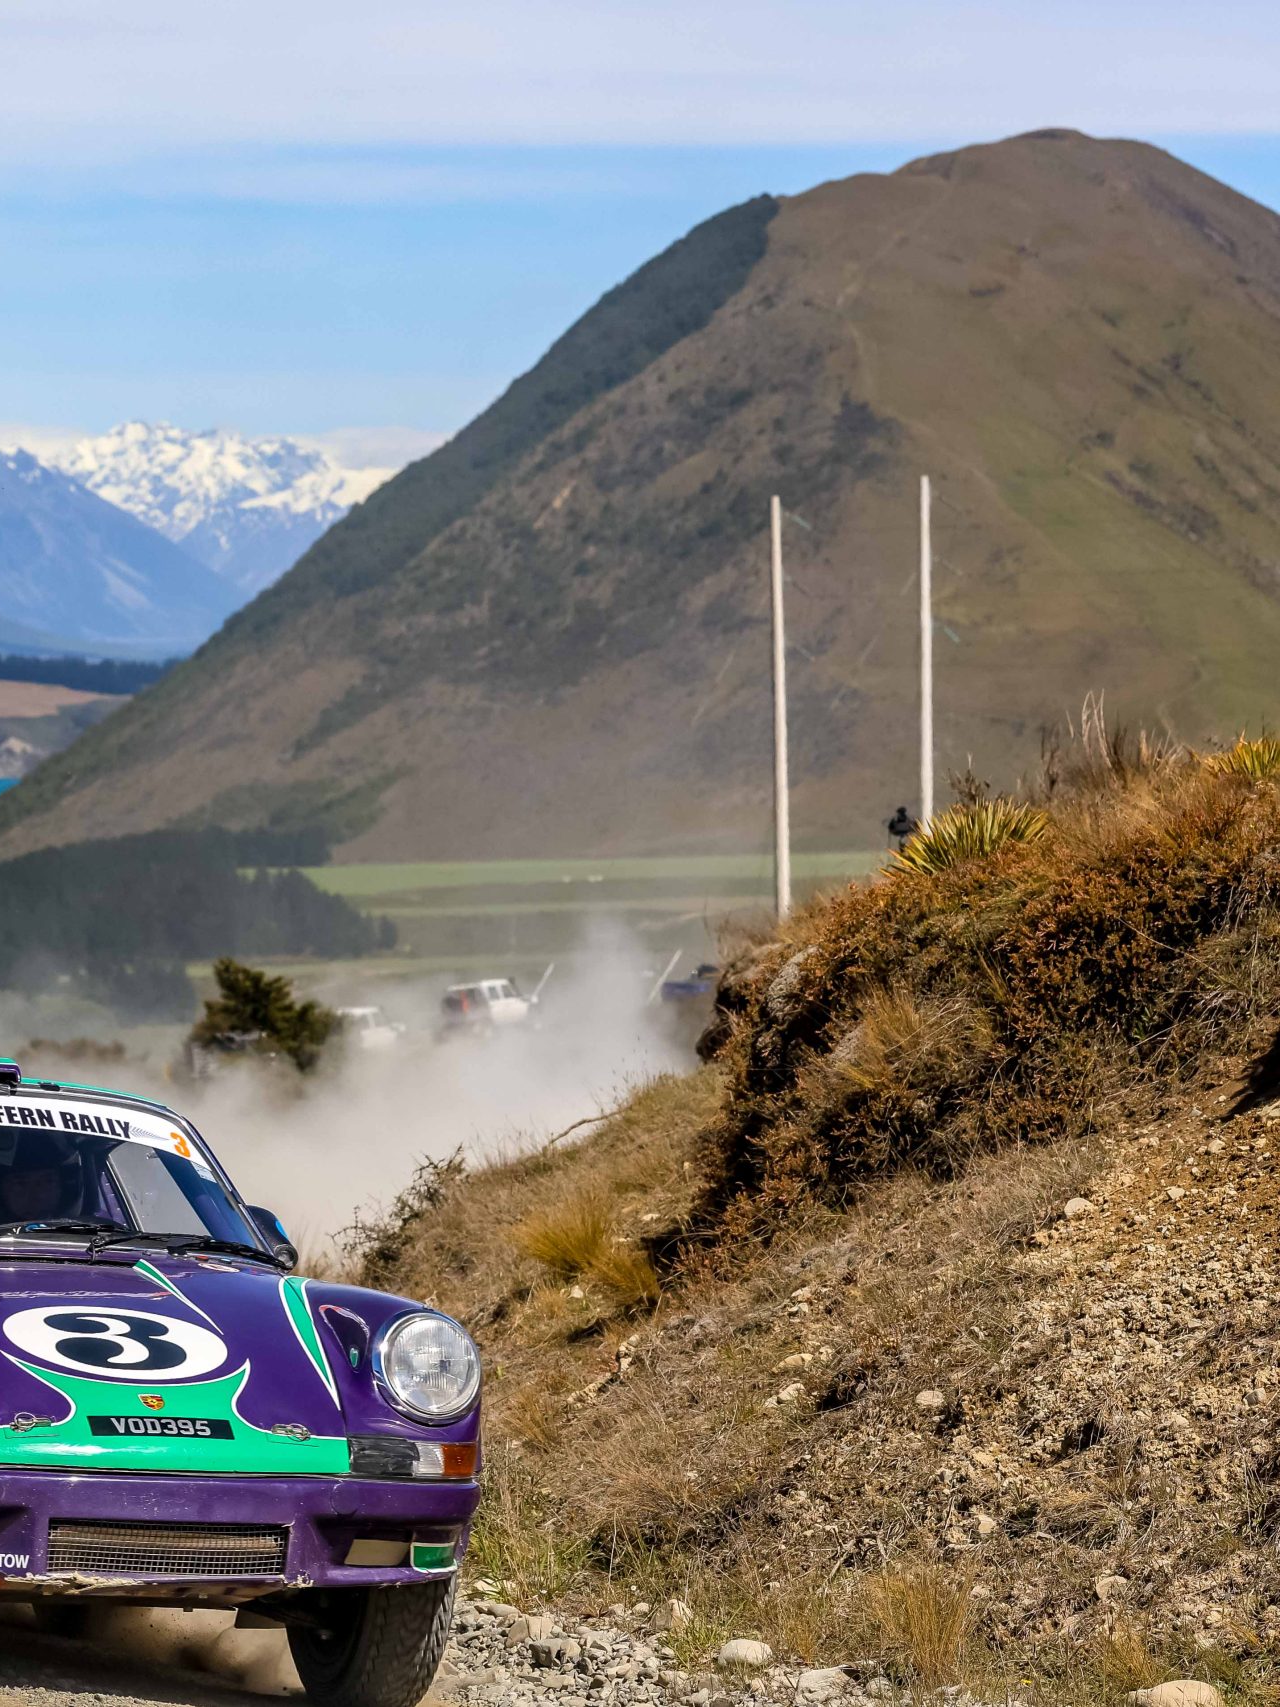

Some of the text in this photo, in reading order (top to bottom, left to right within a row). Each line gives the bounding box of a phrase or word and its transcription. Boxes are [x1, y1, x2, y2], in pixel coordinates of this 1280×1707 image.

[59, 1112, 132, 1139] RALLY
[170, 1132, 191, 1158] 3
[43, 1312, 187, 1371] 3
[110, 1417, 212, 1436] VOD395
